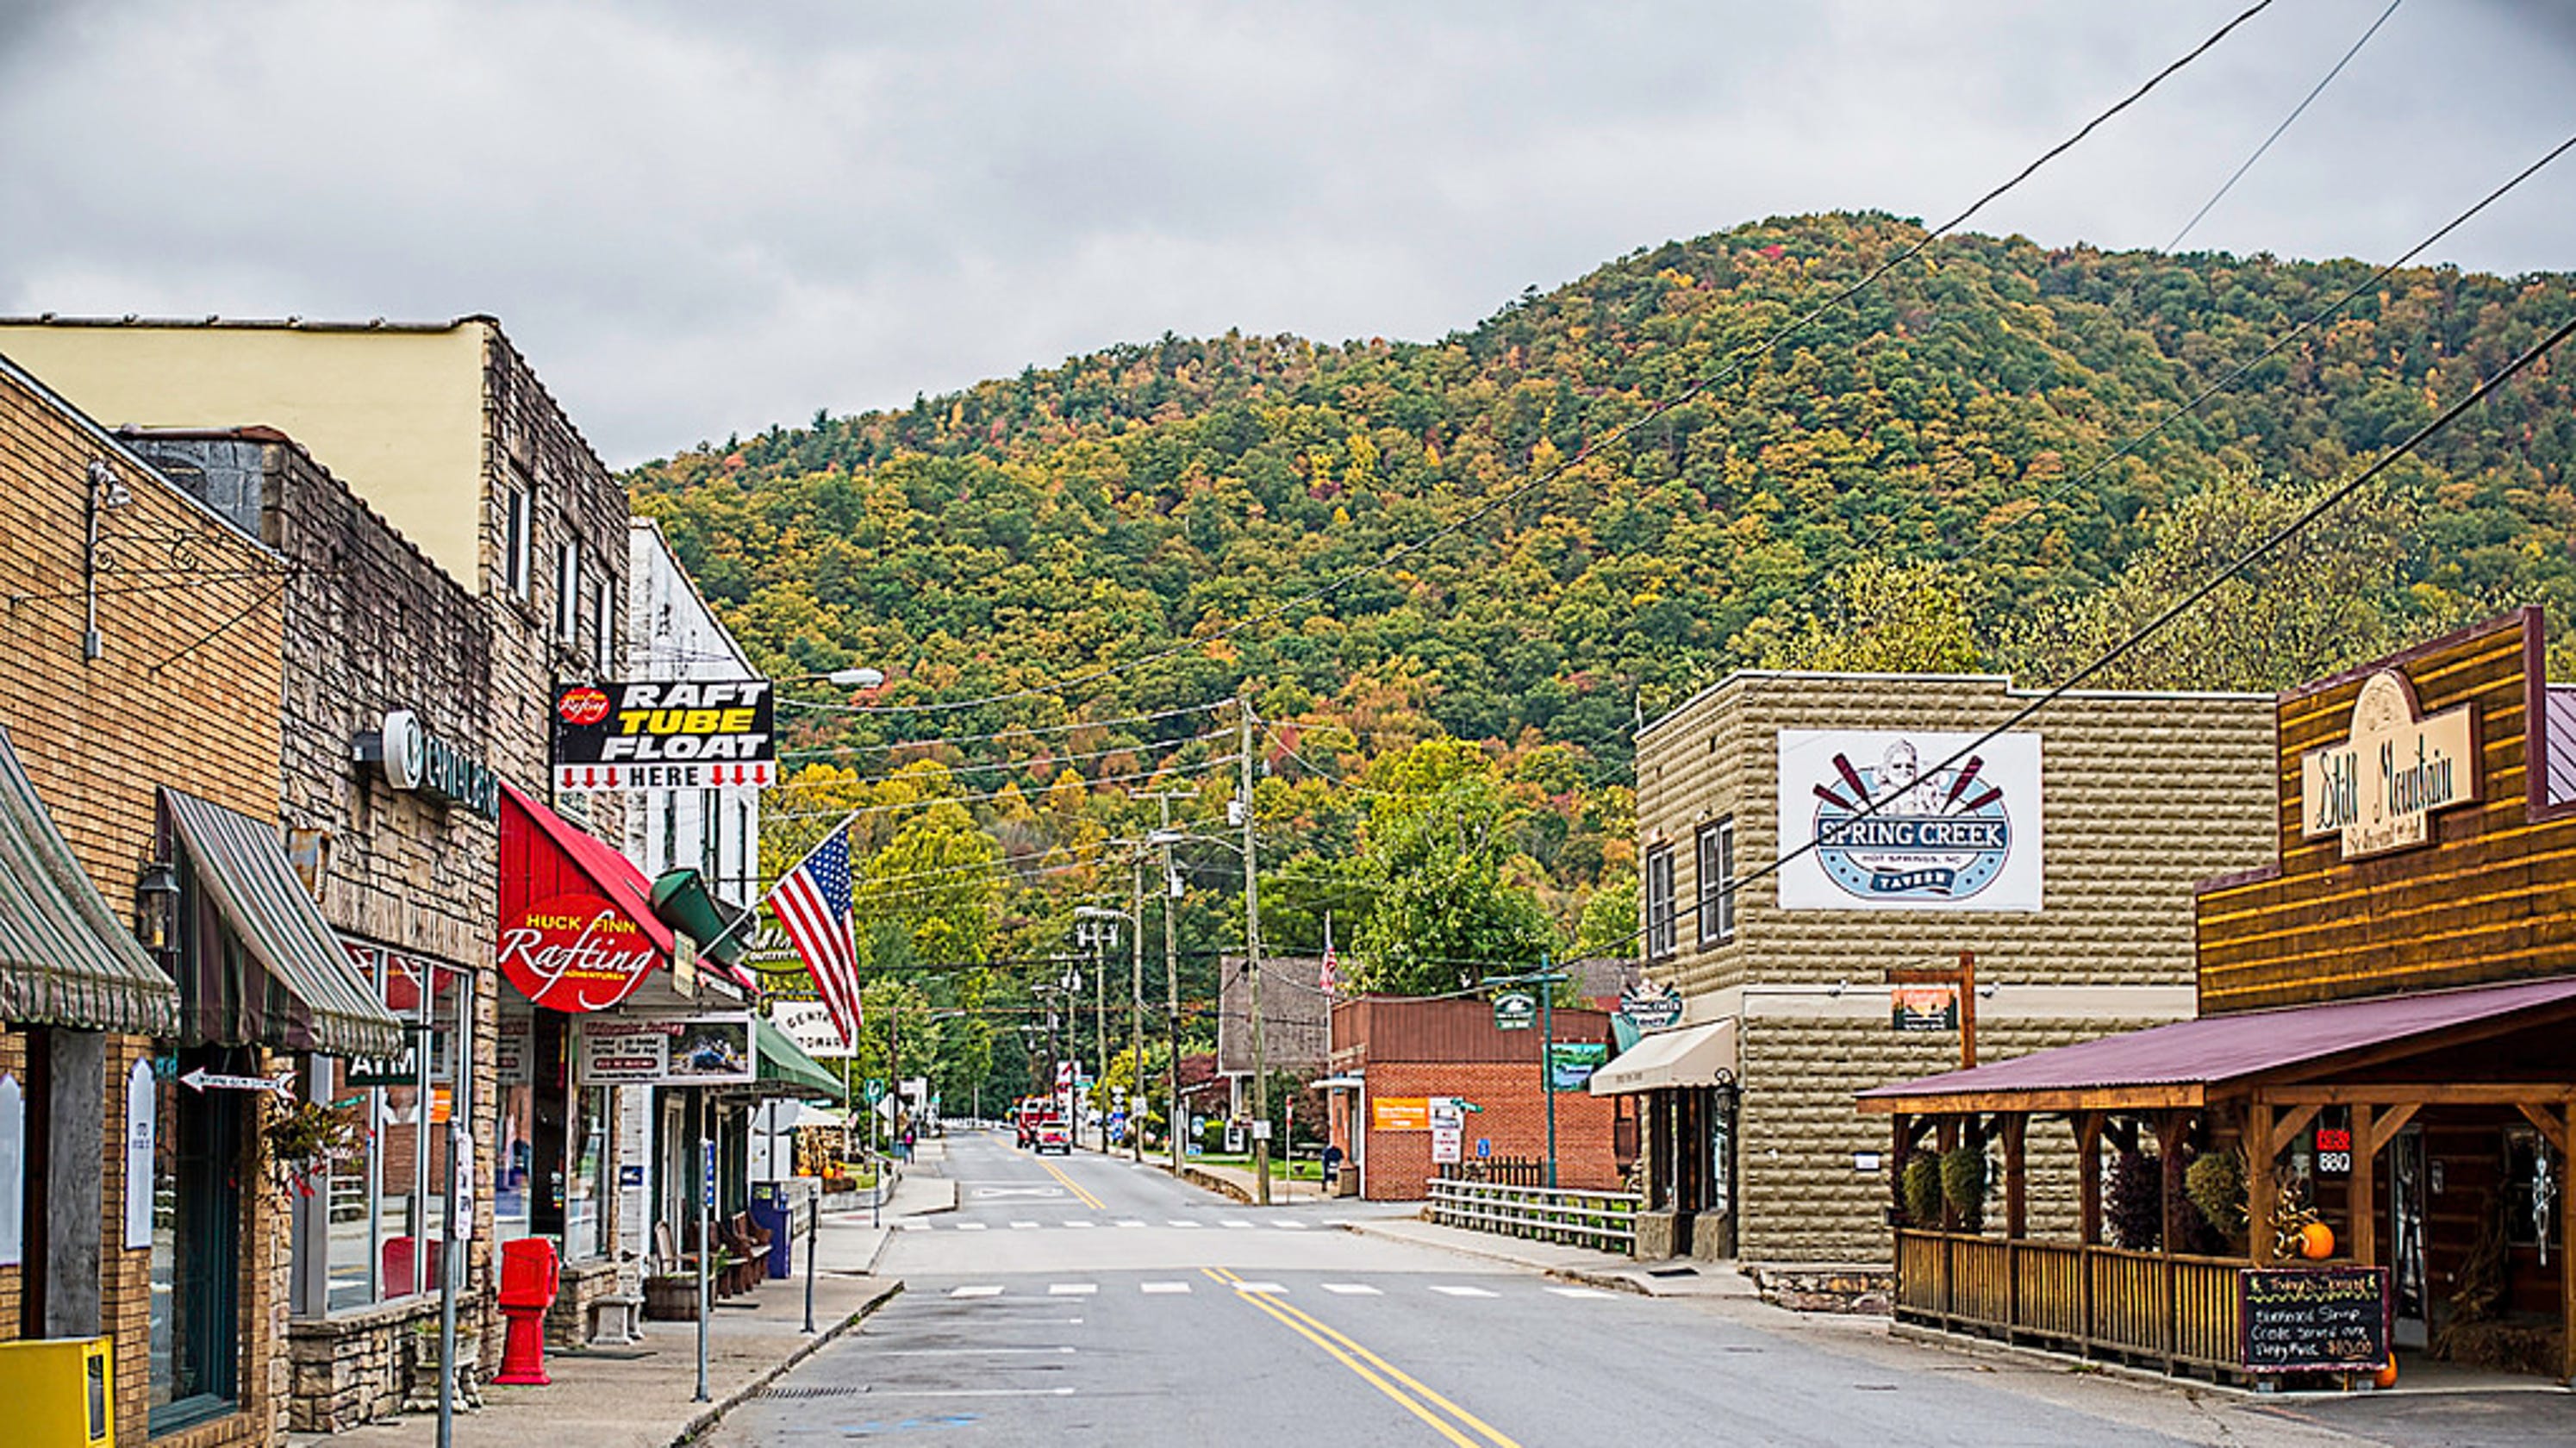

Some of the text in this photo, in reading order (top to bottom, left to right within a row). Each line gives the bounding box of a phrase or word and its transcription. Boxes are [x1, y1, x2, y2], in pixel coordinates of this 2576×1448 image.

[621, 683, 770, 709] RAFT
[618, 708, 757, 735] TUBE
[601, 734, 769, 761] FLOAT
[629, 766, 700, 787] HERE
[1821, 821, 2003, 846] SPRING CREEK
[1887, 855, 1941, 864] SPRINGS,
[1945, 855, 1962, 864] NC
[1880, 871, 1946, 889] TAVERN
[526, 914, 636, 933] HUCK FINN
[497, 908, 655, 1011] Rafting
[349, 1046, 416, 1077] ATM
